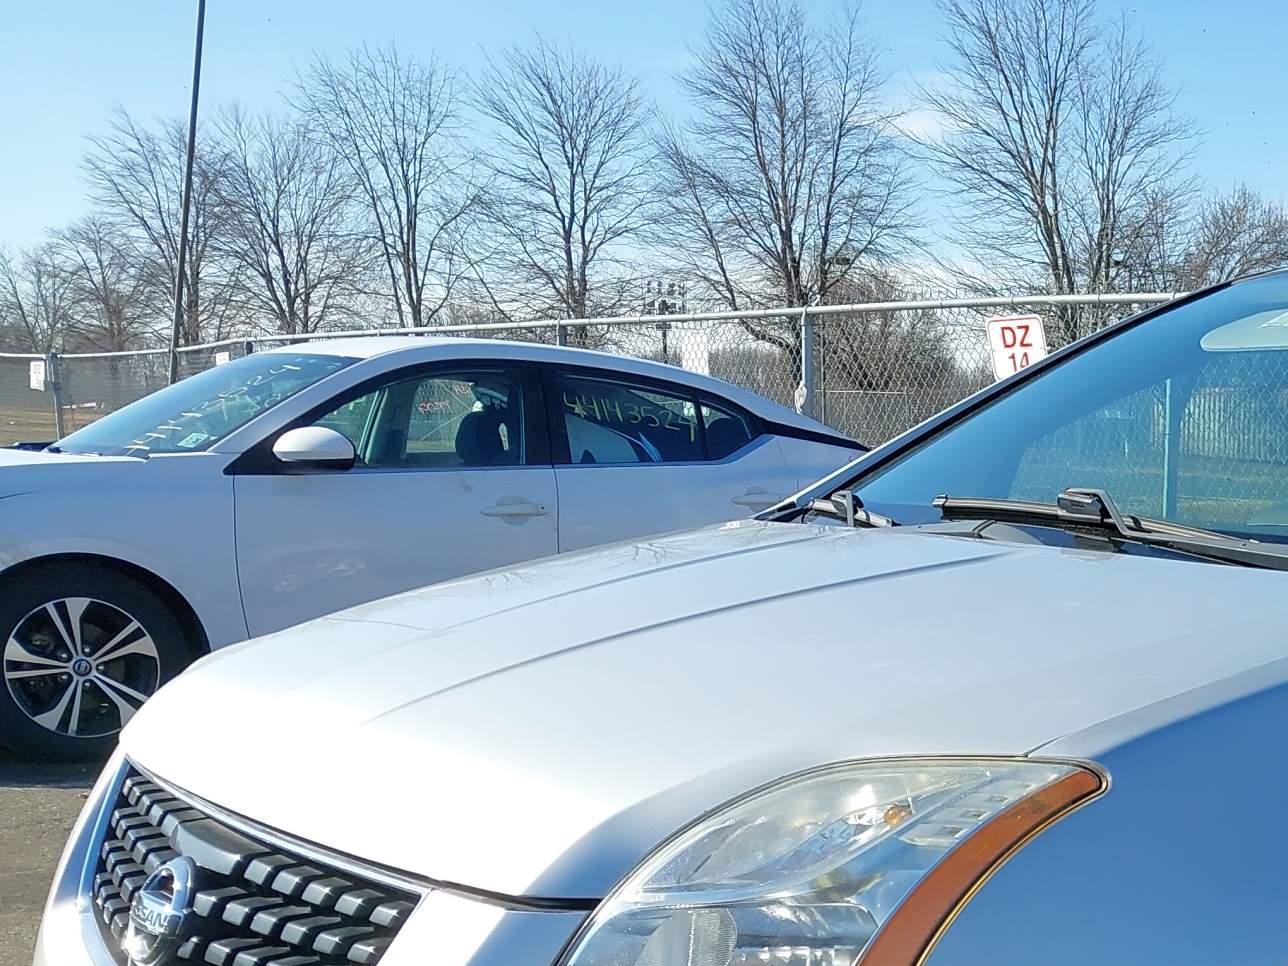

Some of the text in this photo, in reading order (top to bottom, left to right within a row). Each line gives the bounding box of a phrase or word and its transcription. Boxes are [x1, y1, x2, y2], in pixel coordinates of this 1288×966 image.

[1000, 325, 1033, 348] DZ
[562, 391, 698, 443] 44143524
[132, 902, 169, 928] SSAN
